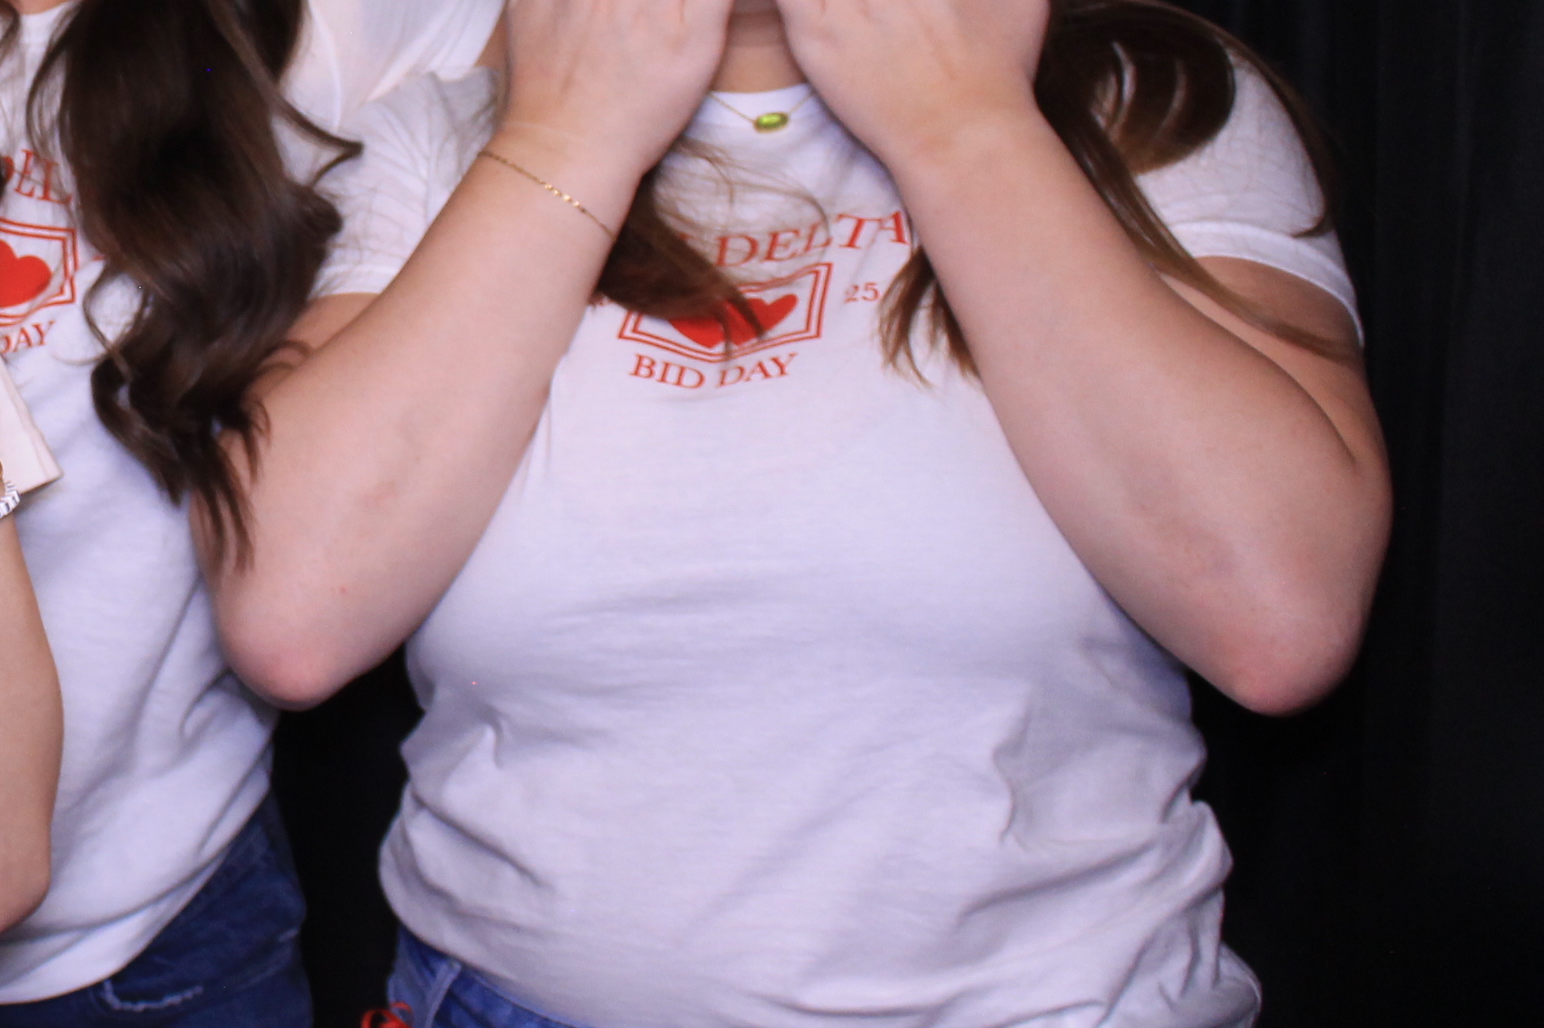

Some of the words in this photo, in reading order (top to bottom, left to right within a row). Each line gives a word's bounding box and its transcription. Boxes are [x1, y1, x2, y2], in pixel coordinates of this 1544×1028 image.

[715, 210, 911, 267] DELTA
[843, 281, 880, 304] 25
[629, 353, 706, 390] BID
[716, 352, 798, 389] DAY
